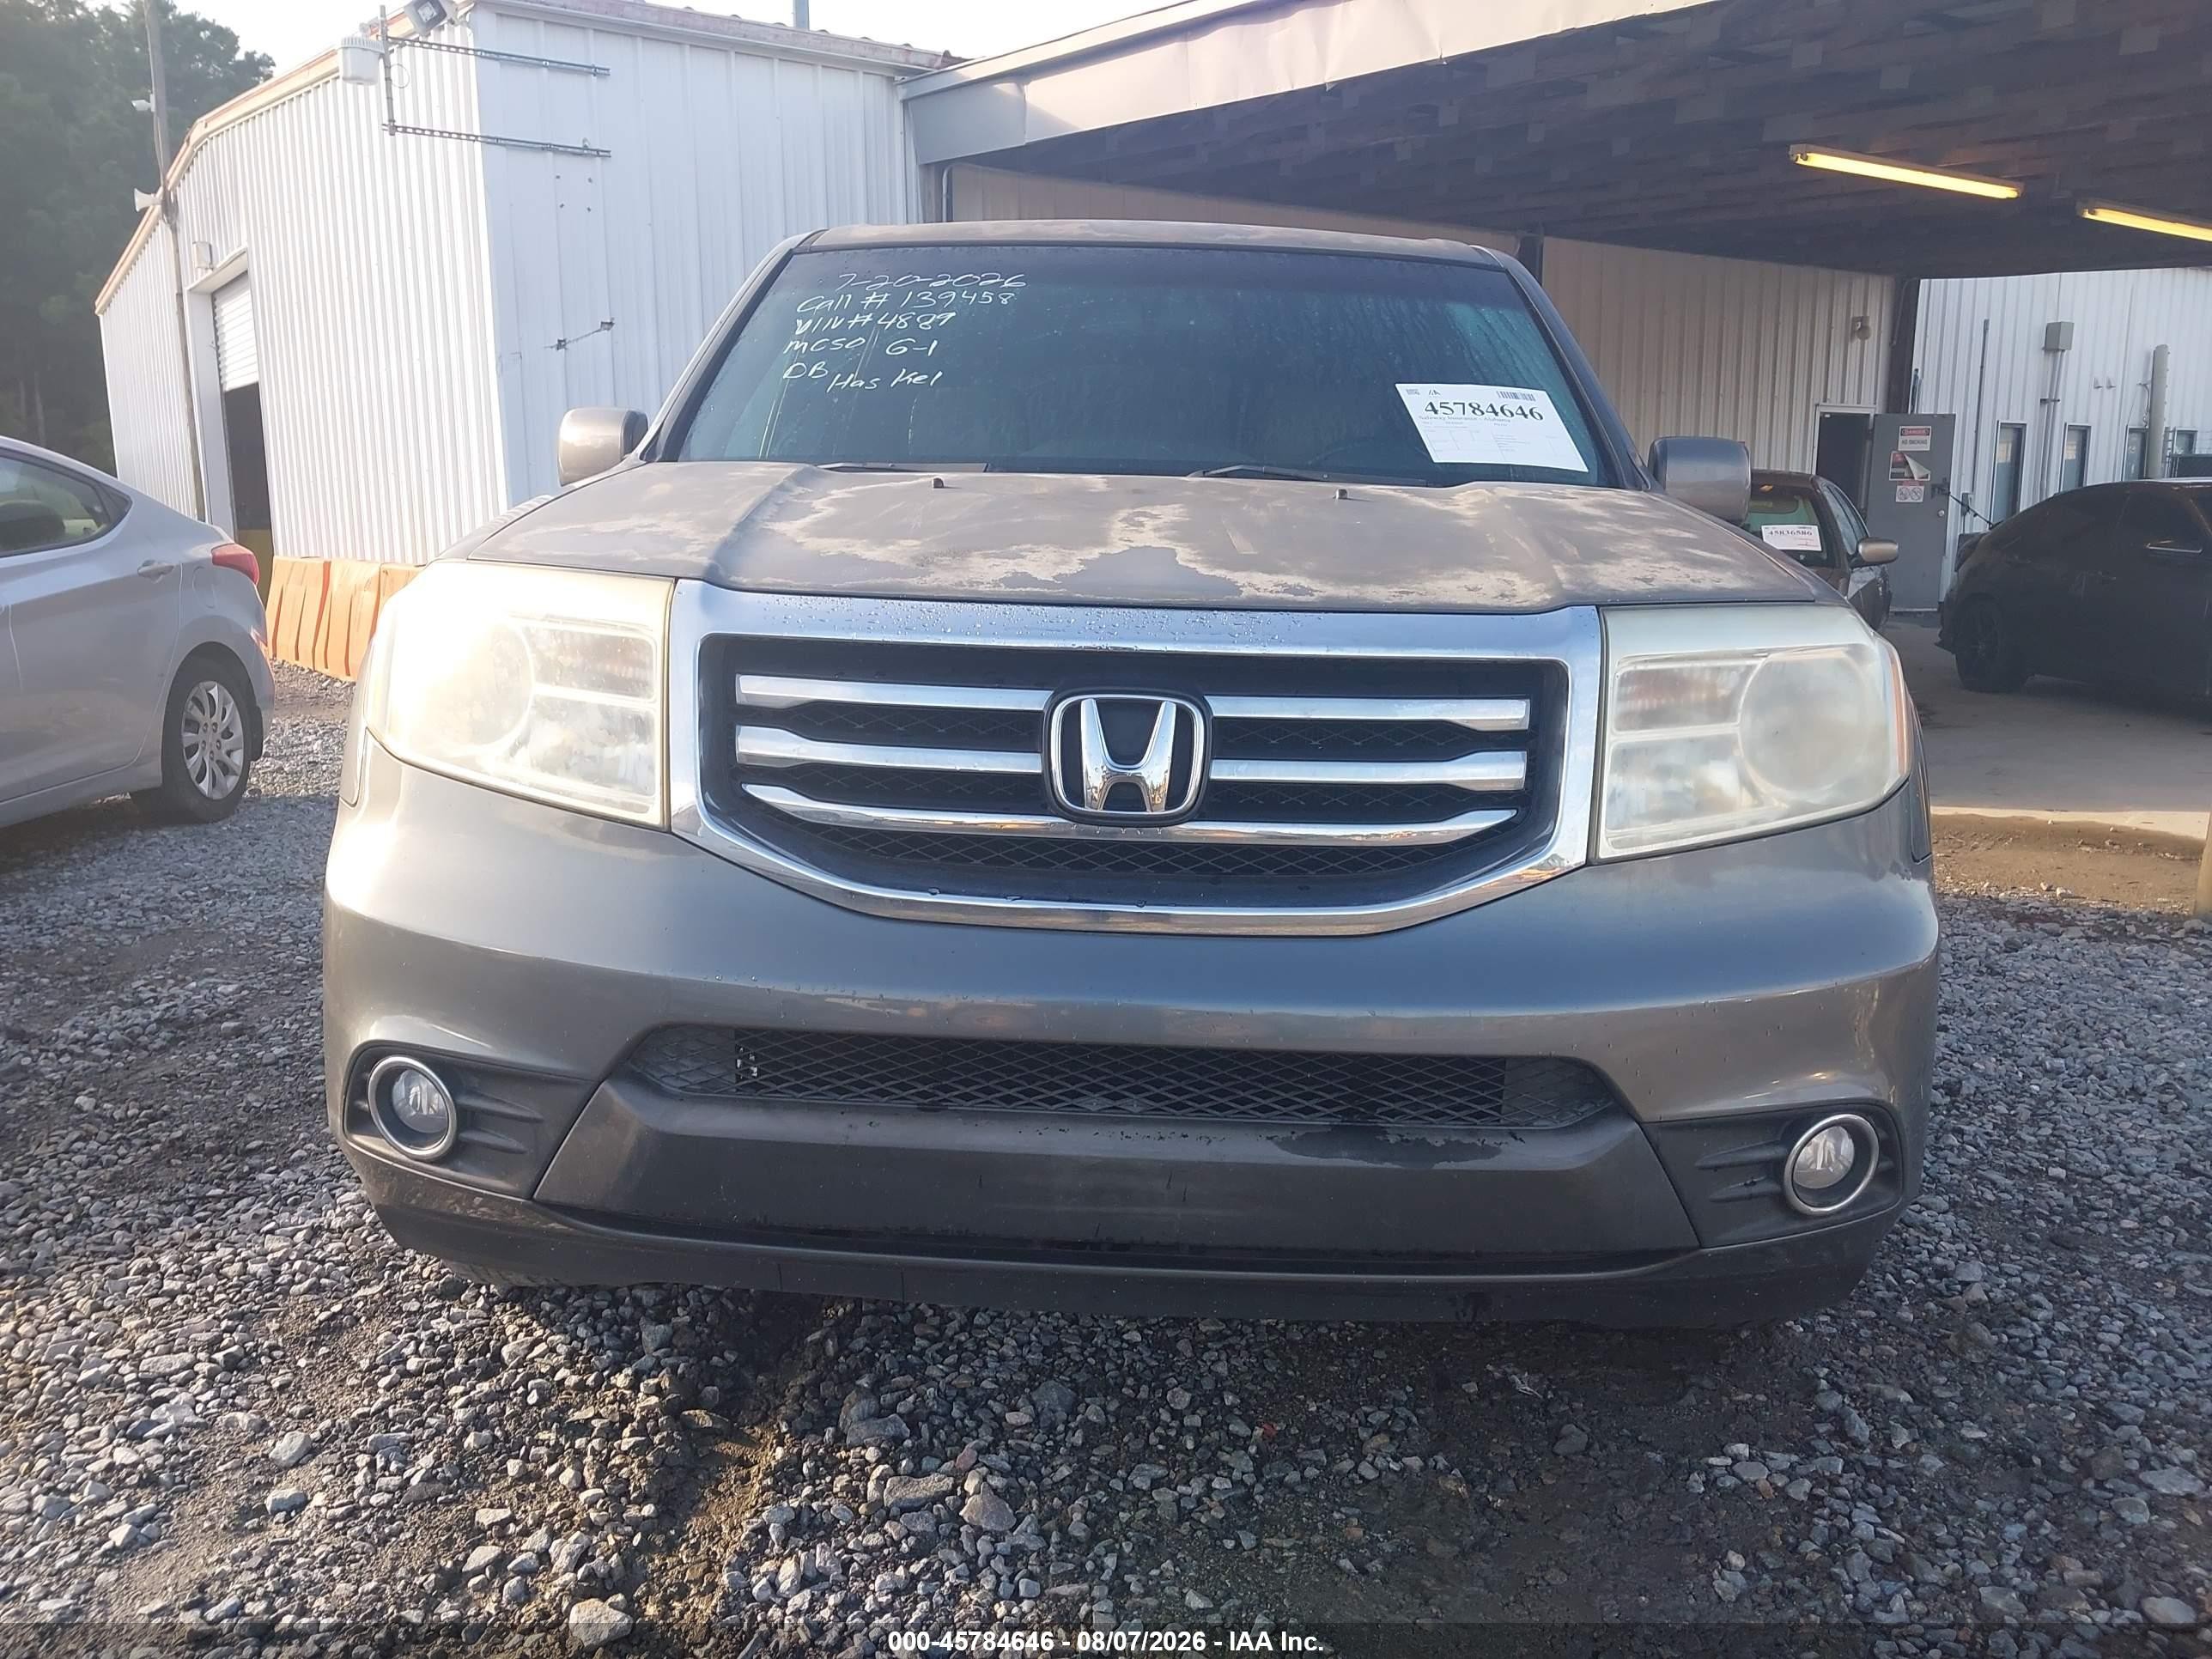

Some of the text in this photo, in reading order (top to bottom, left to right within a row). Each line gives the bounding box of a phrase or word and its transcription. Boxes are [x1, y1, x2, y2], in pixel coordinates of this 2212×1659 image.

[836, 272, 1027, 292] 7-20-2026
[796, 291, 1016, 315] Call # 139458
[1425, 401, 1545, 422] 45784646
